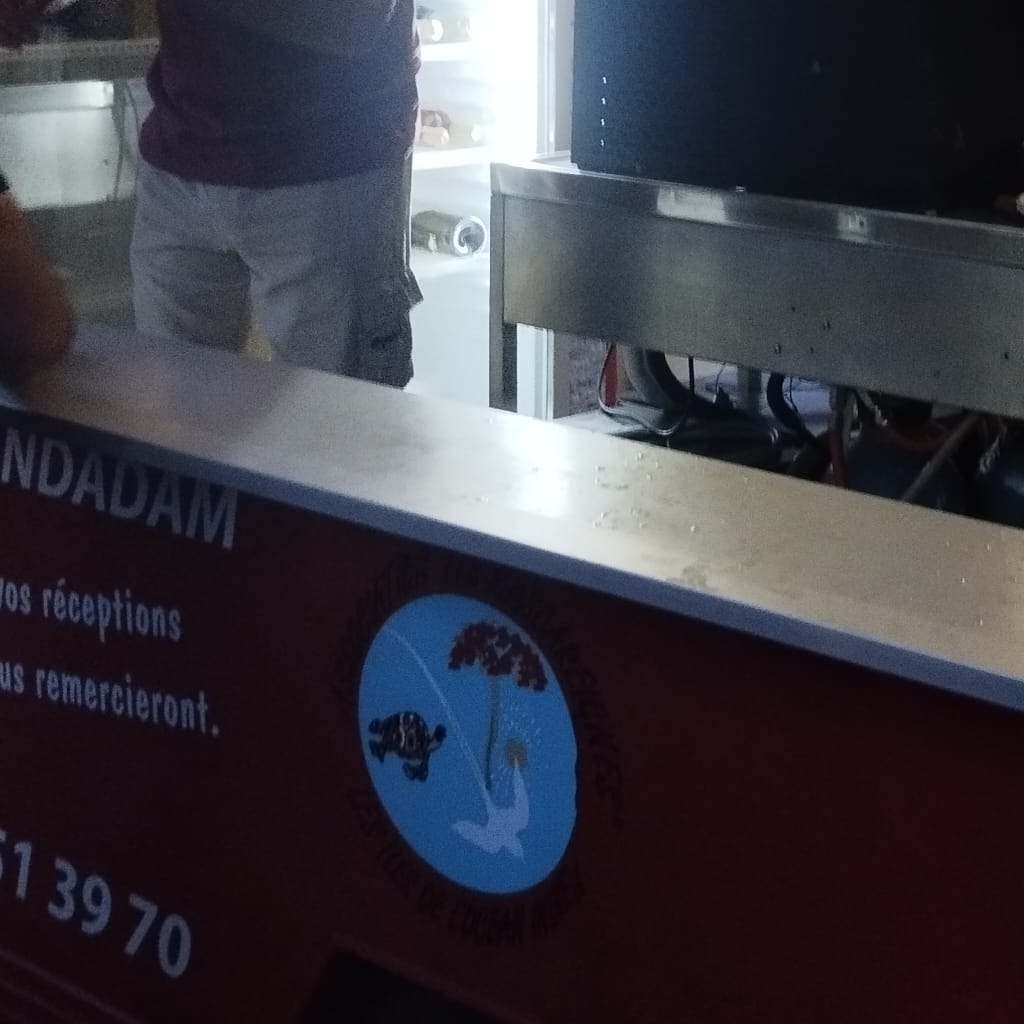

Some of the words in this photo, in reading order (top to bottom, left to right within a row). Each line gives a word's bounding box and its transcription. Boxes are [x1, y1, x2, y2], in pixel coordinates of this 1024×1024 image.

[0, 426, 240, 551] NDADAM
[42, 577, 182, 643] réceptions
[36, 668, 220, 737] remercieront.
[0, 829, 32, 900] 1
[48, 856, 112, 935] 39
[124, 892, 192, 979] 70
